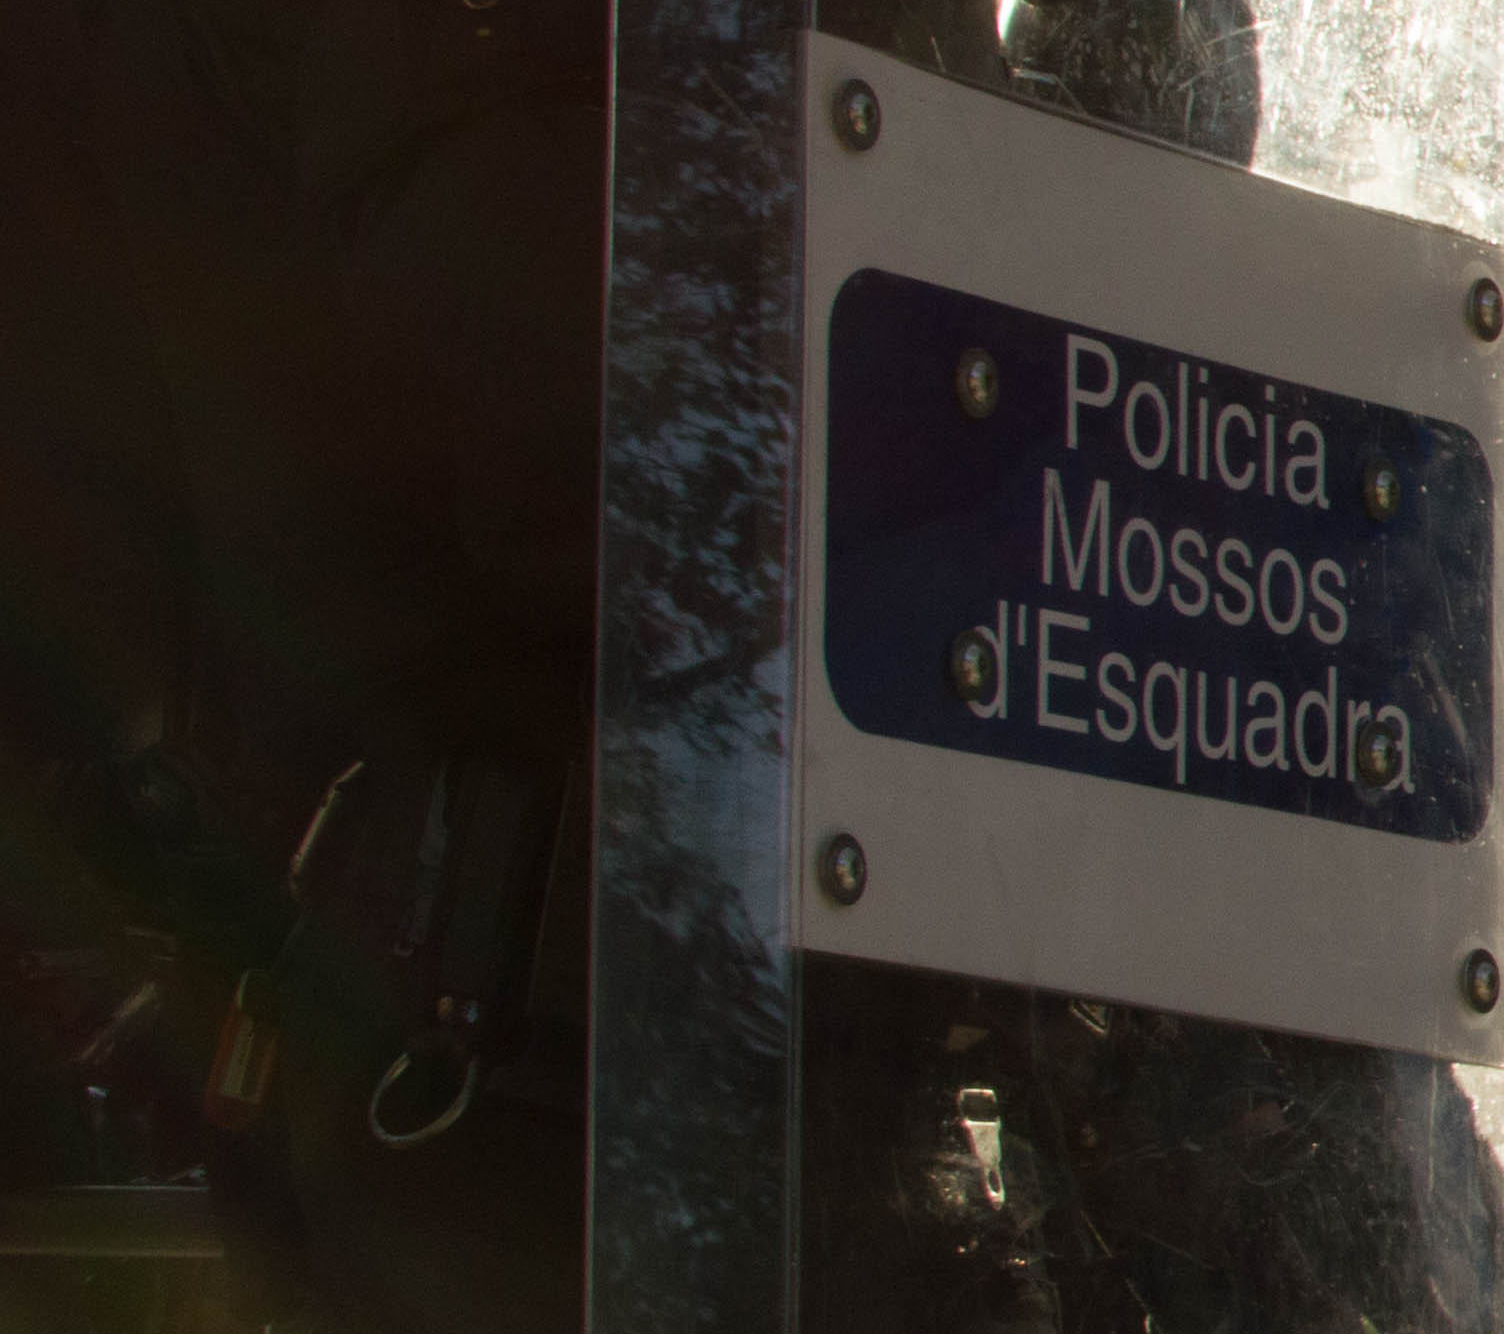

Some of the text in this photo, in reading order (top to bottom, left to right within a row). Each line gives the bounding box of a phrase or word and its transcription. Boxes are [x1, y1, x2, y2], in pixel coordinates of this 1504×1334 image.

[1064, 332, 1331, 510] Policia
[1040, 467, 1350, 645] Mossos
[957, 600, 1416, 794] d'Esquadra
